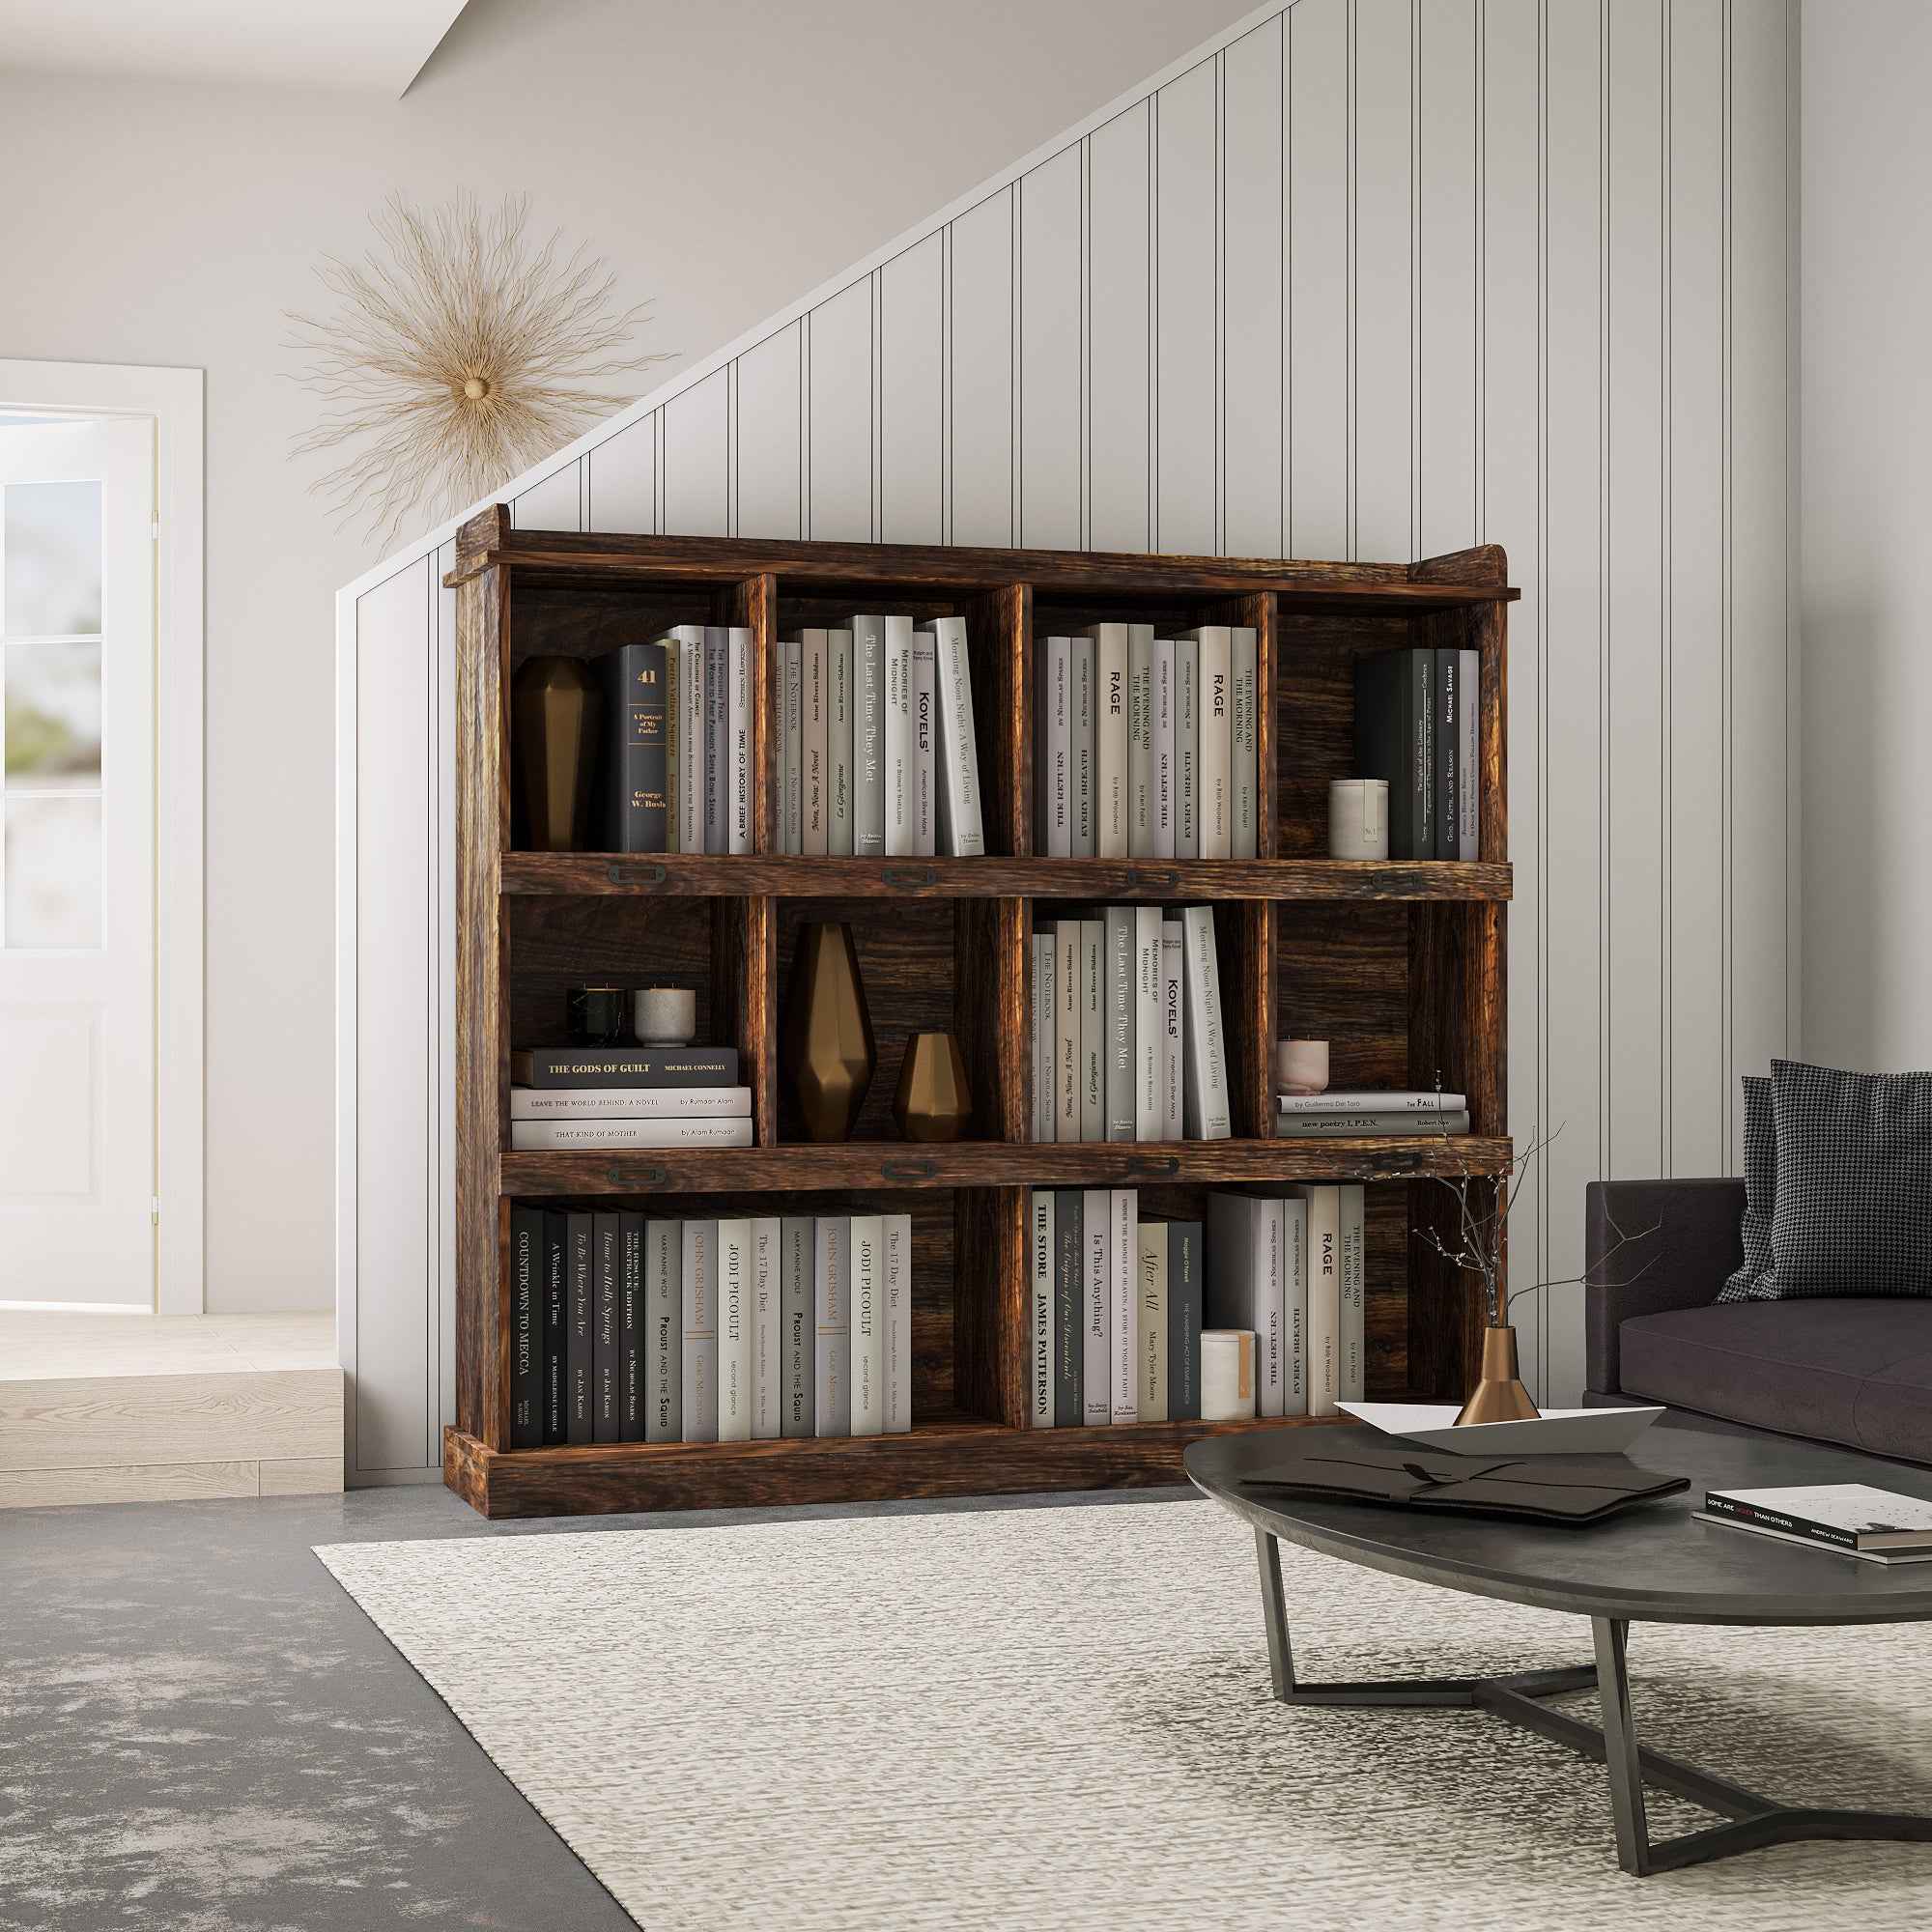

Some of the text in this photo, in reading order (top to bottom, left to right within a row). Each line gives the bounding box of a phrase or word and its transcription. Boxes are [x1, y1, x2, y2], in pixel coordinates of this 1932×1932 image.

[951, 638, 960, 675] Morning
[637, 669, 656, 685] 41
[954, 678, 963, 700] Noon
[789, 659, 799, 730] THE NOTEBOOK
[1111, 671, 1121, 715] RAGE
[1213, 674, 1224, 717] RAGE
[865, 635, 877, 782] The Last Time They Met
[901, 703, 909, 715] OF
[738, 753, 746, 766] OF
[958, 744, 969, 761] Way
[961, 764, 970, 774] of
[962, 776, 972, 805] Living
[738, 831, 746, 839] A
[1116, 925, 1128, 1070] The Last Time They Met
[1151, 991, 1159, 1003] OF
[549, 1064, 650, 1073] THE GODS OF GUILT
[1417, 1098, 1435, 1107] FALL
[555, 1129, 638, 1138] THAT KIND OF MOTHER
[756, 1235, 768, 1254] The
[887, 1231, 898, 1251] The
[1037, 1205, 1047, 1279] THE STORE
[1322, 1233, 1334, 1275] RAGE
[756, 1256, 768, 1267] 17
[887, 1253, 898, 1264] 17
[577, 1233, 586, 1337] To Be Where You Are
[602, 1231, 612, 1346] Home to Holly Springs
[756, 1270, 768, 1290] Day
[861, 1240, 870, 1337] JODI PICOULT
[887, 1266, 898, 1286] Day
[1092, 1235, 1103, 1338] Is This Anything?
[1142, 1247, 1159, 1312] After All
[518, 1231, 529, 1376] COUNTDOWN TO MECCA
[552, 1292, 559, 1300] in
[727, 1244, 739, 1341] JODI PICOULT
[756, 1293, 768, 1313] Diet
[887, 1288, 898, 1308] Diet
[660, 1317, 669, 1350] PROUST
[793, 1312, 803, 1347] PROUST
[1037, 1293, 1047, 1415] JAMES PATTERSON
[1148, 1331, 1157, 1402] Mary Tyler Moore
[660, 1398, 669, 1428] SQUID
[793, 1392, 803, 1422] SQUID
